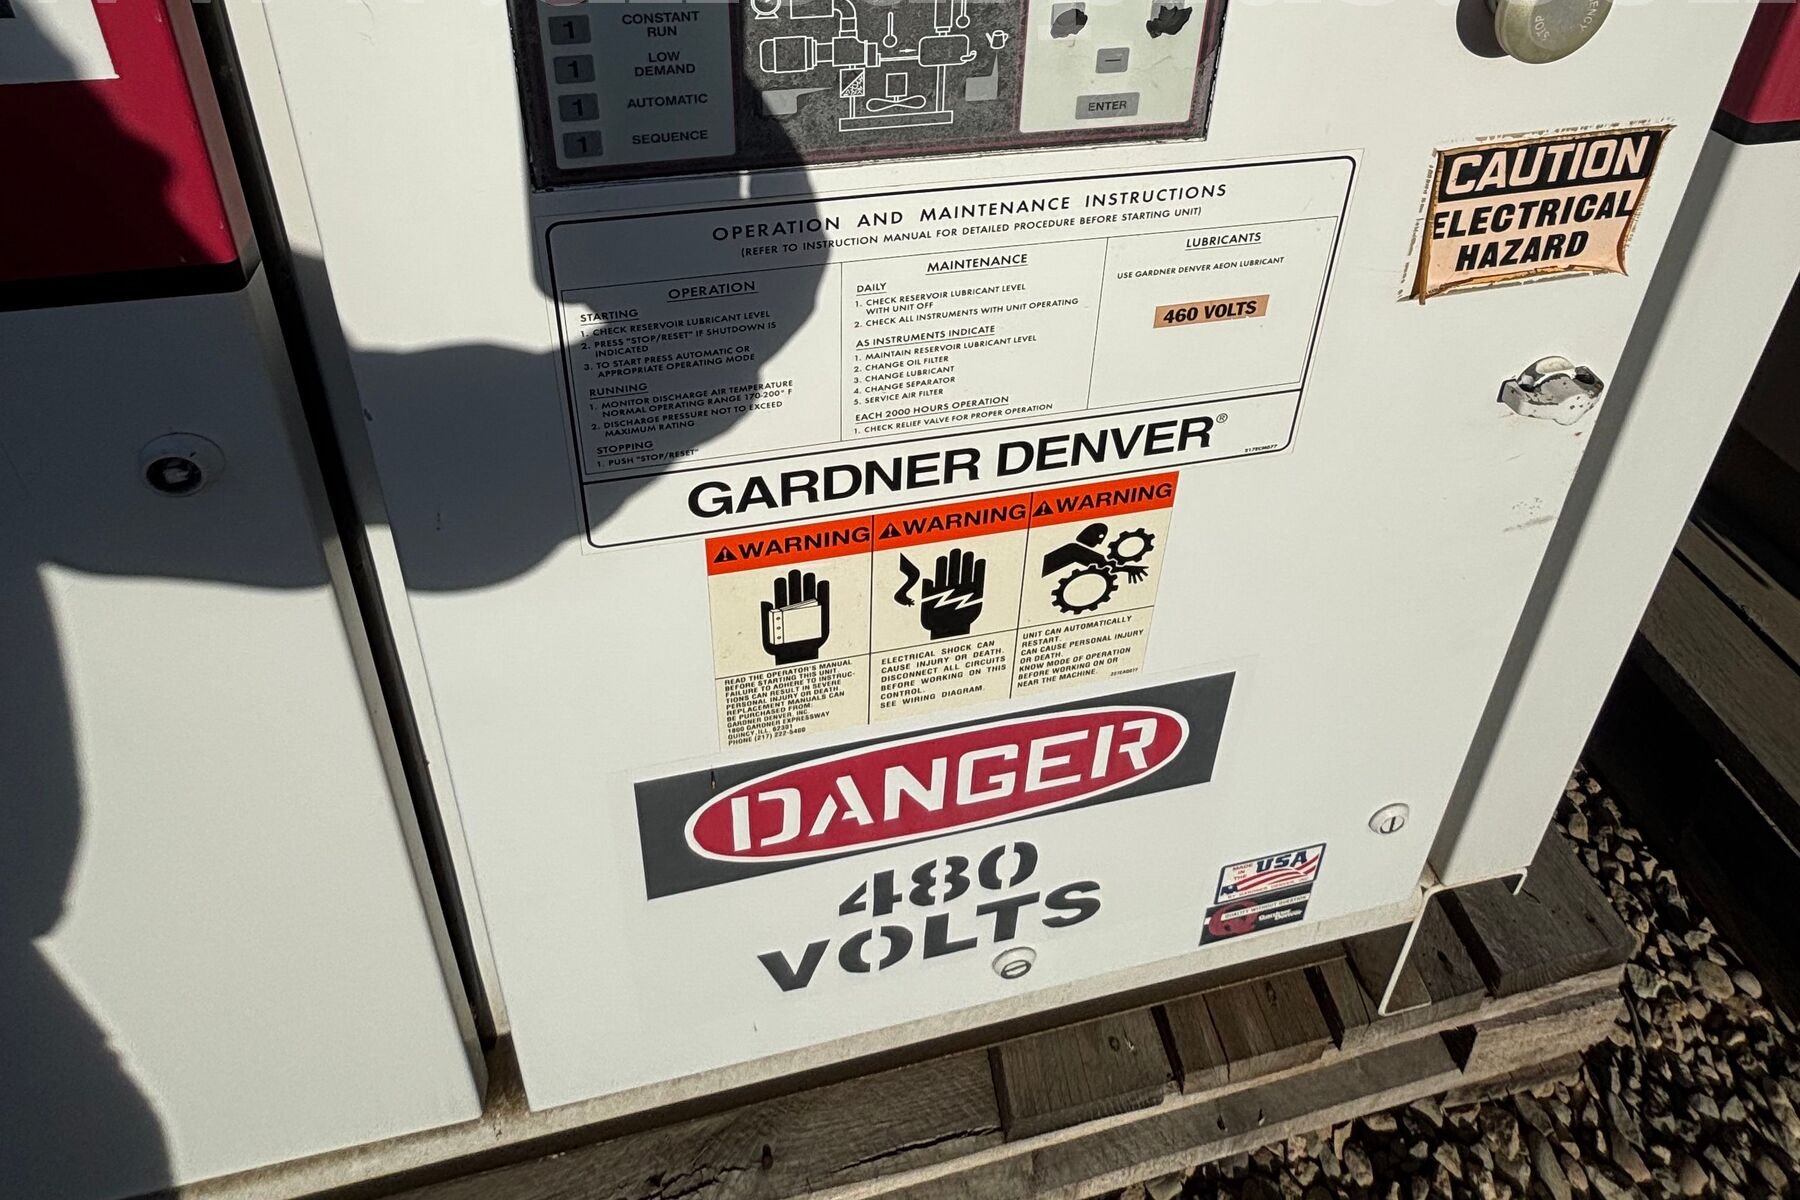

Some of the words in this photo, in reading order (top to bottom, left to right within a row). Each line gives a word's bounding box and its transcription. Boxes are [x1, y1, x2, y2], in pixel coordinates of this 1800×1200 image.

[622, 11, 700, 24] CONSTANT
[647, 26, 677, 37] RUN
[648, 51, 680, 63] LOW
[634, 63, 696, 77] DEMAND
[627, 93, 708, 109] AUTOMATIC
[1088, 100, 1127, 112] ENTER
[632, 130, 708, 145] SEQUENCE
[1445, 136, 1649, 195] CAUTION
[713, 217, 839, 241] OPERATION
[857, 211, 902, 228] AND
[919, 197, 1069, 223] MAINTENANCE
[1085, 183, 1226, 208] INSTRUCTIONS
[1433, 189, 1635, 240] ELECTRICAL
[741, 243, 780, 256] (REFER
[782, 241, 801, 253] TO
[801, 234, 878, 251] INSTRUCTION
[883, 229, 931, 243] MANUAL
[935, 227, 957, 239] FOR
[961, 222, 1009, 236] DETAILED
[1013, 217, 1075, 232] PROCEDURE
[1079, 213, 1117, 226] BEFORE
[1121, 208, 1170, 222] STARTING
[1174, 205, 1202, 217] UNIT)
[1186, 232, 1263, 248] LUBRICANTS
[1455, 230, 1589, 272] HAZARD
[927, 254, 1028, 272] MAINTENANCE
[1117, 271, 1132, 279] USE
[1134, 267, 1176, 278] GARDNER
[1177, 264, 1211, 273] DENVER
[1212, 261, 1237, 270] AEON
[1238, 256, 1285, 267] LUBRICANT
[668, 281, 755, 299] OPERATION
[857, 282, 887, 293] DAILY
[865, 297, 896, 306] CHECK
[899, 292, 947, 303] RESERVOIR
[950, 287, 999, 298] LUBRICANT
[1001, 284, 1026, 293] LEVEL
[580, 309, 638, 322] STARTING
[854, 320, 862, 328] 2.
[865, 317, 896, 327] CHECK
[898, 315, 914, 323] ALL
[916, 308, 978, 321] INSTRUMENTS
[980, 306, 1003, 315] WITH
[1005, 303, 1026, 312] UNIT
[1028, 298, 1078, 310] OPERATING
[866, 306, 889, 316] WITH
[892, 304, 913, 313] UNIT
[916, 302, 934, 310] OFF
[1163, 307, 1199, 324] 460
[1202, 300, 1259, 319] VOLTS
[580, 329, 589, 338] 1.
[592, 326, 627, 337] CHECK
[629, 320, 684, 332] RESERVOIR
[686, 314, 741, 326] LUBRICANT
[743, 311, 770, 320] LEVEL
[856, 339, 869, 348] AS
[872, 331, 945, 346] INSTRUMENTS
[948, 325, 996, 337] INDICATE
[865, 349, 911, 360] MAINTAIN
[913, 343, 961, 355] RESERVOIR
[963, 338, 1010, 349] LUBRICANT
[1013, 335, 1037, 344] LEVEL
[864, 361, 904, 371] CHANGE
[923, 355, 949, 364] FILTER
[864, 371, 903, 382] CHANGE
[906, 366, 955, 377] LUBRICANT
[589, 383, 647, 397] RUNNING
[864, 382, 903, 393] CHANGE
[905, 376, 956, 388] SEPARATOR
[864, 393, 899, 404] SERVICE
[901, 391, 916, 399] AIR
[918, 388, 944, 397] FILTER
[855, 411, 882, 421] EACH
[884, 407, 910, 418] 2000
[912, 403, 949, 414] HOURS
[951, 395, 1009, 410] OPERATION
[863, 423, 893, 433] CHECK
[895, 420, 921, 429] RELIEF
[923, 416, 949, 425] VALVE
[951, 414, 968, 422] FOR
[970, 409, 1002, 419] PROPER
[1004, 403, 1053, 415] OPERATION
[597, 440, 653, 454] STOPPING
[687, 448, 981, 519] GARDNER
[1052, 482, 1173, 512] WARNING
[902, 504, 1026, 537] WARNING
[739, 527, 870, 560] WARNING
[1022, 630, 1042, 639] UNIT
[1044, 627, 1061, 636] CAN
[1063, 616, 1133, 633] AUTOMATICALLY
[881, 650, 935, 665] ELECTRICAL
[941, 644, 971, 655] SHOCK
[976, 640, 995, 649] CAN
[1021, 647, 1037, 656] CAN
[1039, 643, 1066, 653] CAUSE
[1068, 635, 1112, 648] PERSONAL
[1113, 630, 1144, 640] INJURY
[881, 663, 910, 673] CAUSE
[916, 657, 949, 668] INJURY
[954, 654, 967, 662] OR
[881, 667, 937, 682] DISCONNECT
[943, 663, 959, 672] ALL
[964, 656, 1006, 668] CIRCUITS
[1019, 662, 1044, 672] KNOW
[1045, 658, 1070, 668] MODE
[1084, 647, 1132, 661] OPERATION
[725, 677, 746, 685] READ
[748, 674, 763, 682] THE
[766, 665, 816, 679] OPERATOR'S
[818, 659, 852, 670] MANUAL
[1017, 679, 1039, 688] NEAR
[1041, 676, 1056, 684] THE
[880, 700, 896, 708] SEE
[901, 693, 935, 705] WIRING
[731, 718, 1158, 852] DANGER
[1256, 850, 1308, 873] USA
[838, 841, 1038, 918] 480
[757, 880, 1101, 991] VOLTS
